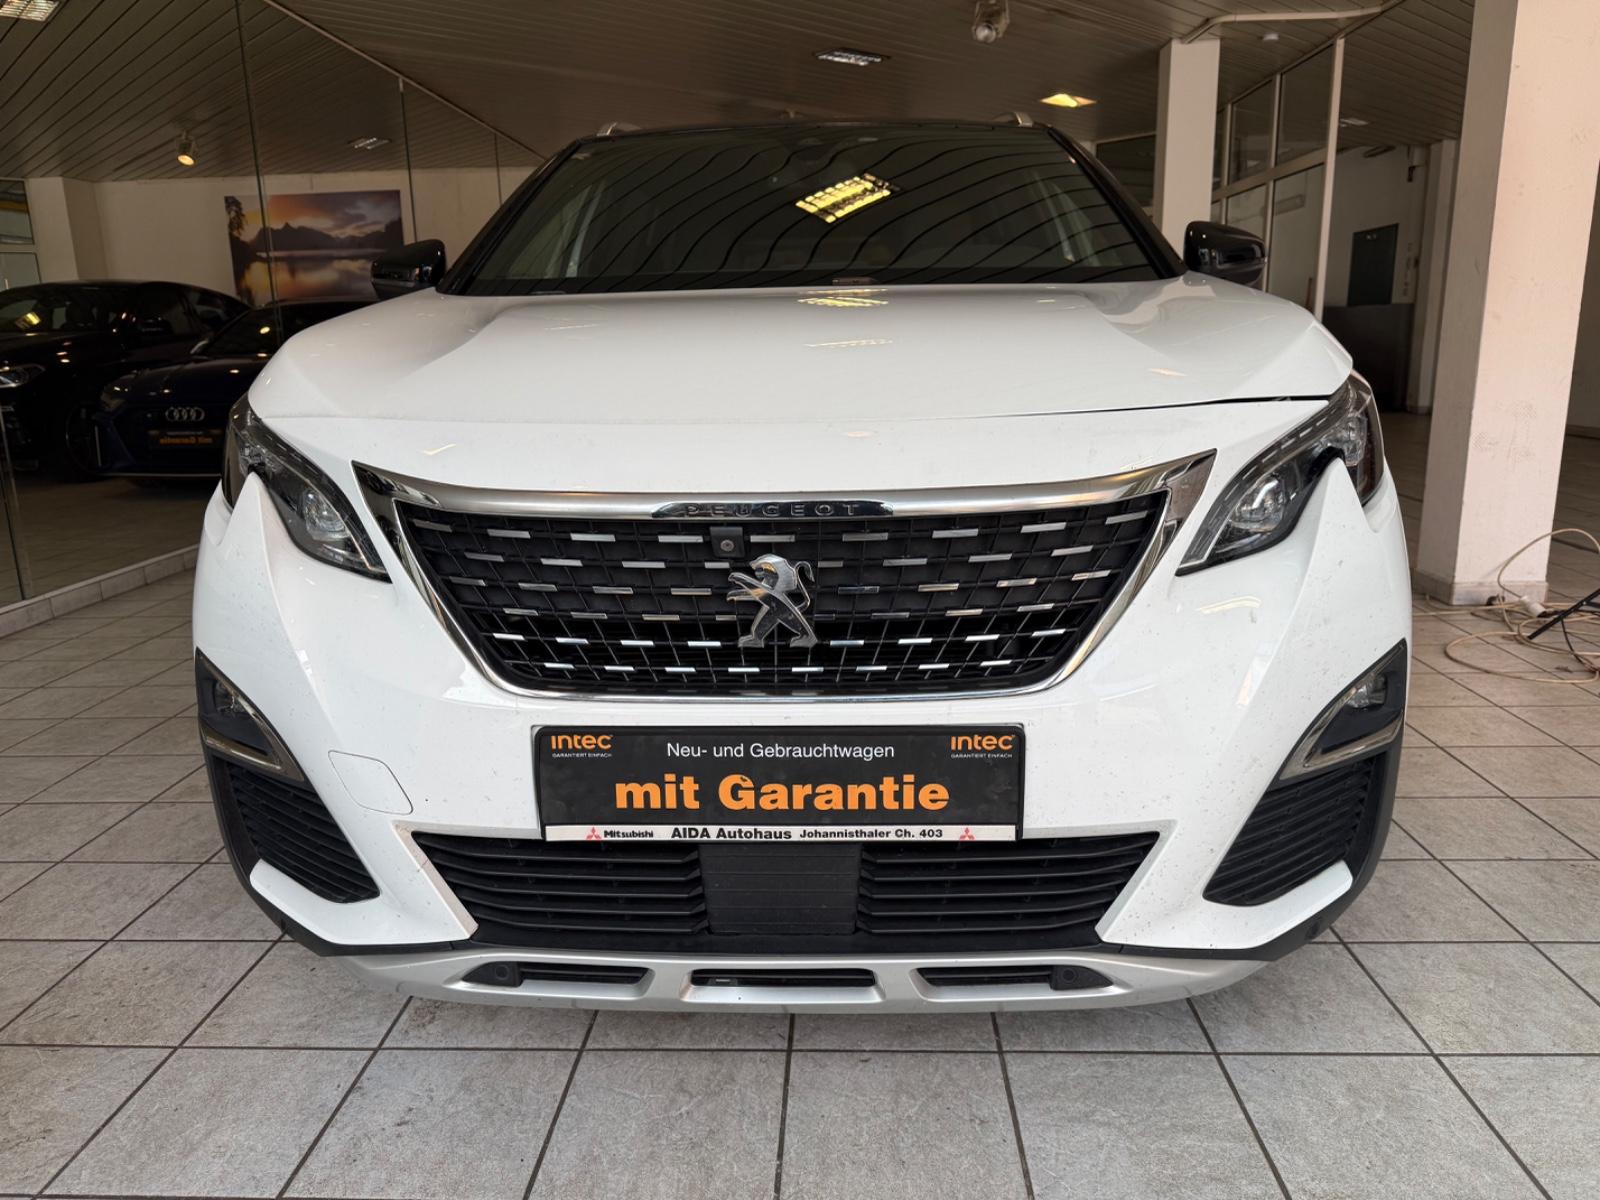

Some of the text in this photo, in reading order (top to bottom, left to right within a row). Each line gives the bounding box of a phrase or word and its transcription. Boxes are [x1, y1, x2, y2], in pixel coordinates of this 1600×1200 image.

[685, 503, 859, 517] PEUGEOT
[667, 743, 895, 761] Neu- und Gebrauchtwagen
[615, 774, 950, 810] mit Garantie
[604, 830, 654, 838] Mitsubishi
[671, 828, 943, 839] AIDA Autohaus Johannisthaler Ch. 403
